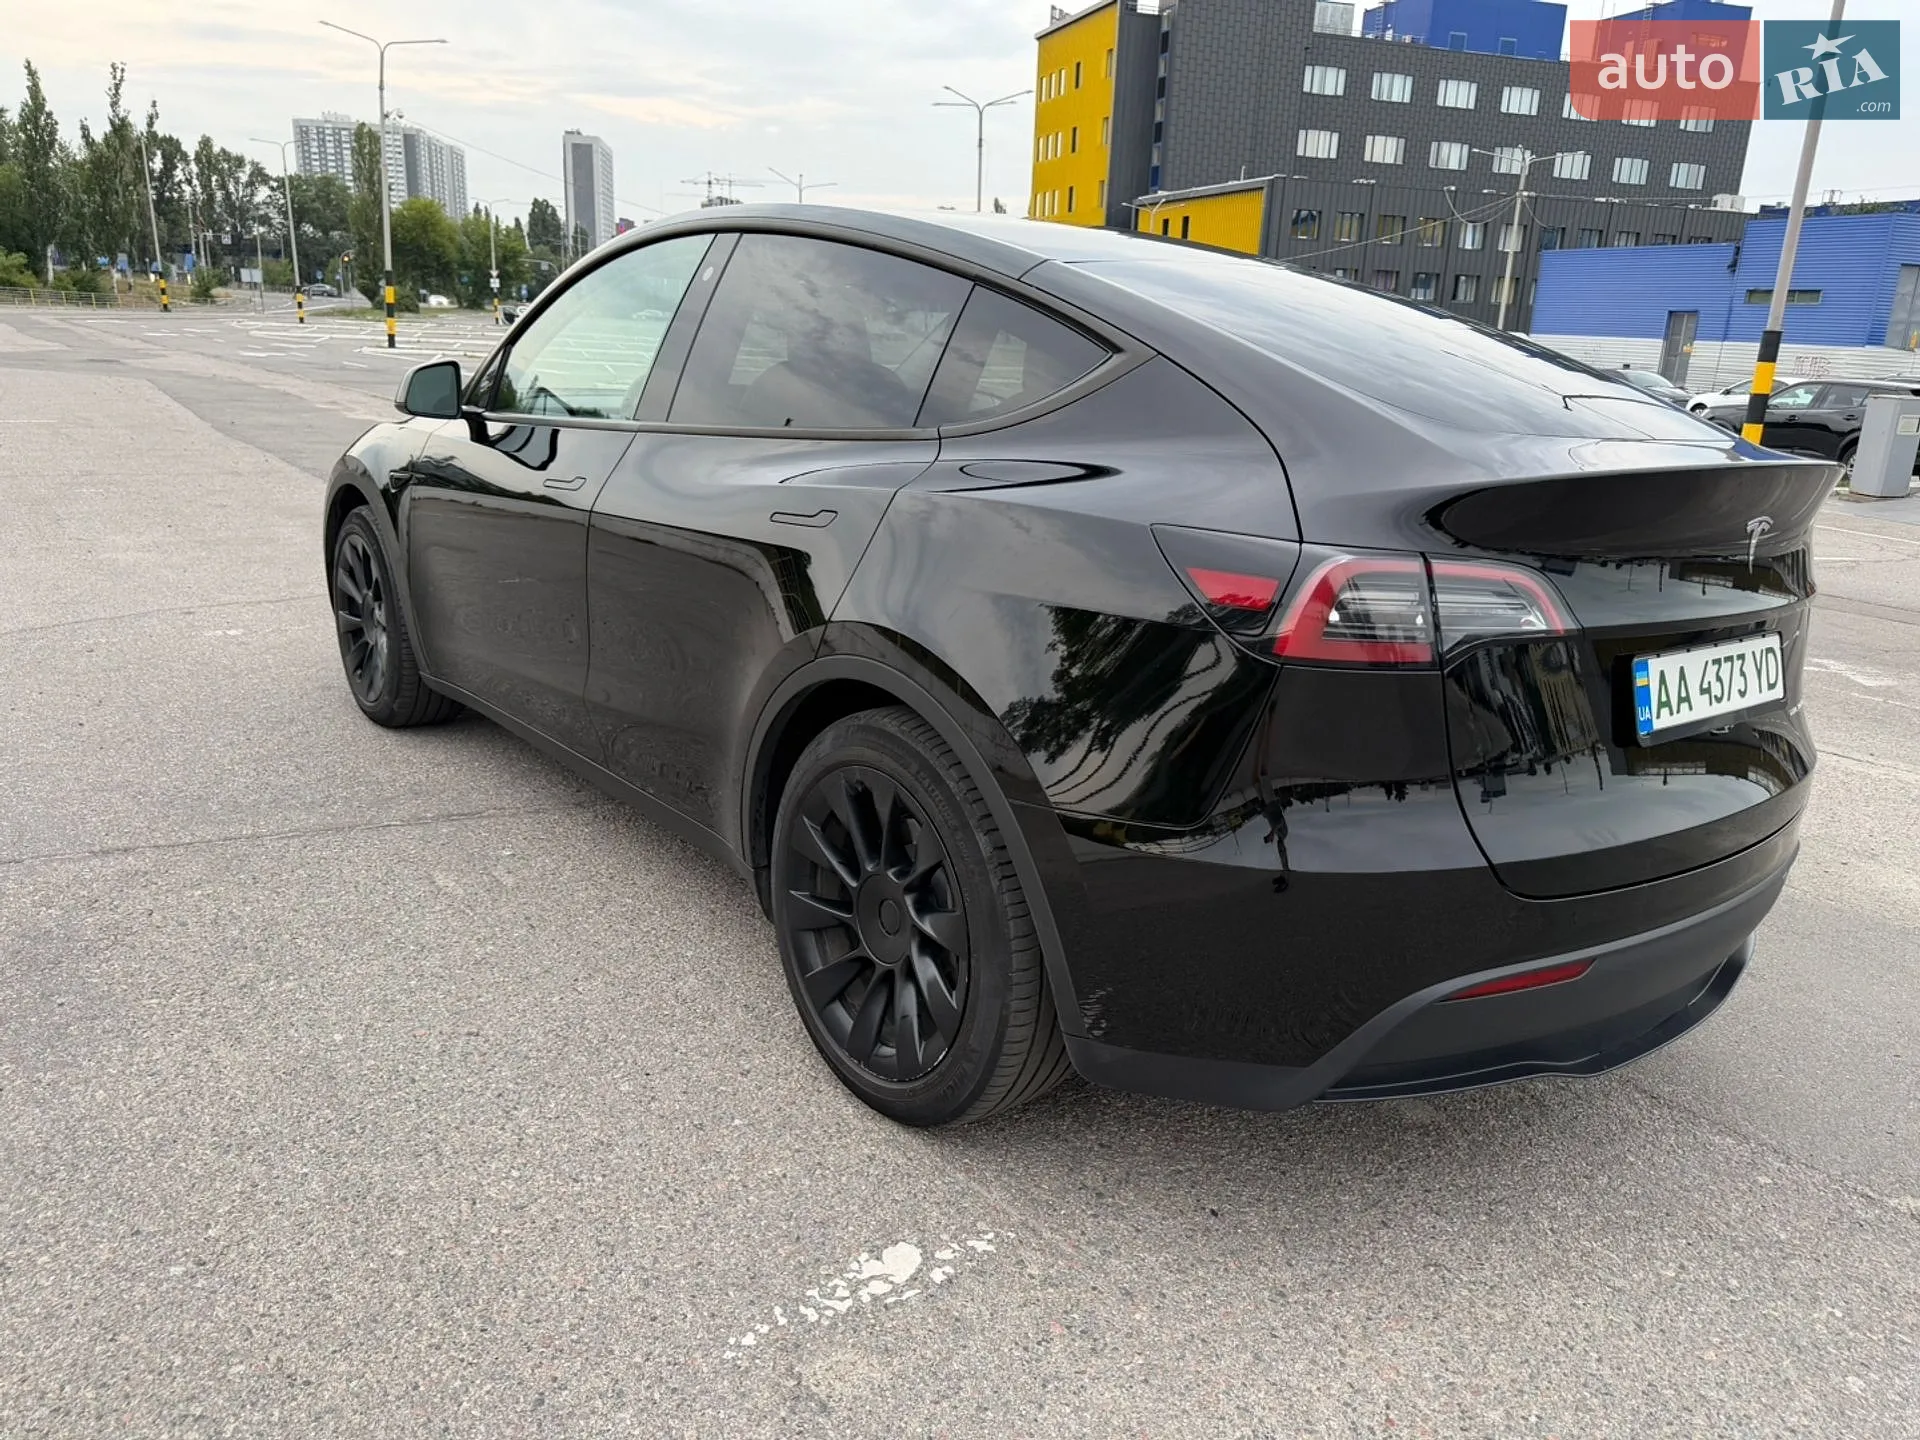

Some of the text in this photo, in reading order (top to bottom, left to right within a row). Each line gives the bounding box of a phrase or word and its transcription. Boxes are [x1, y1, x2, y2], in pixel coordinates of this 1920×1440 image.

[1655, 646, 1779, 719] AA 4373 YD
[1638, 705, 1651, 721] UA
